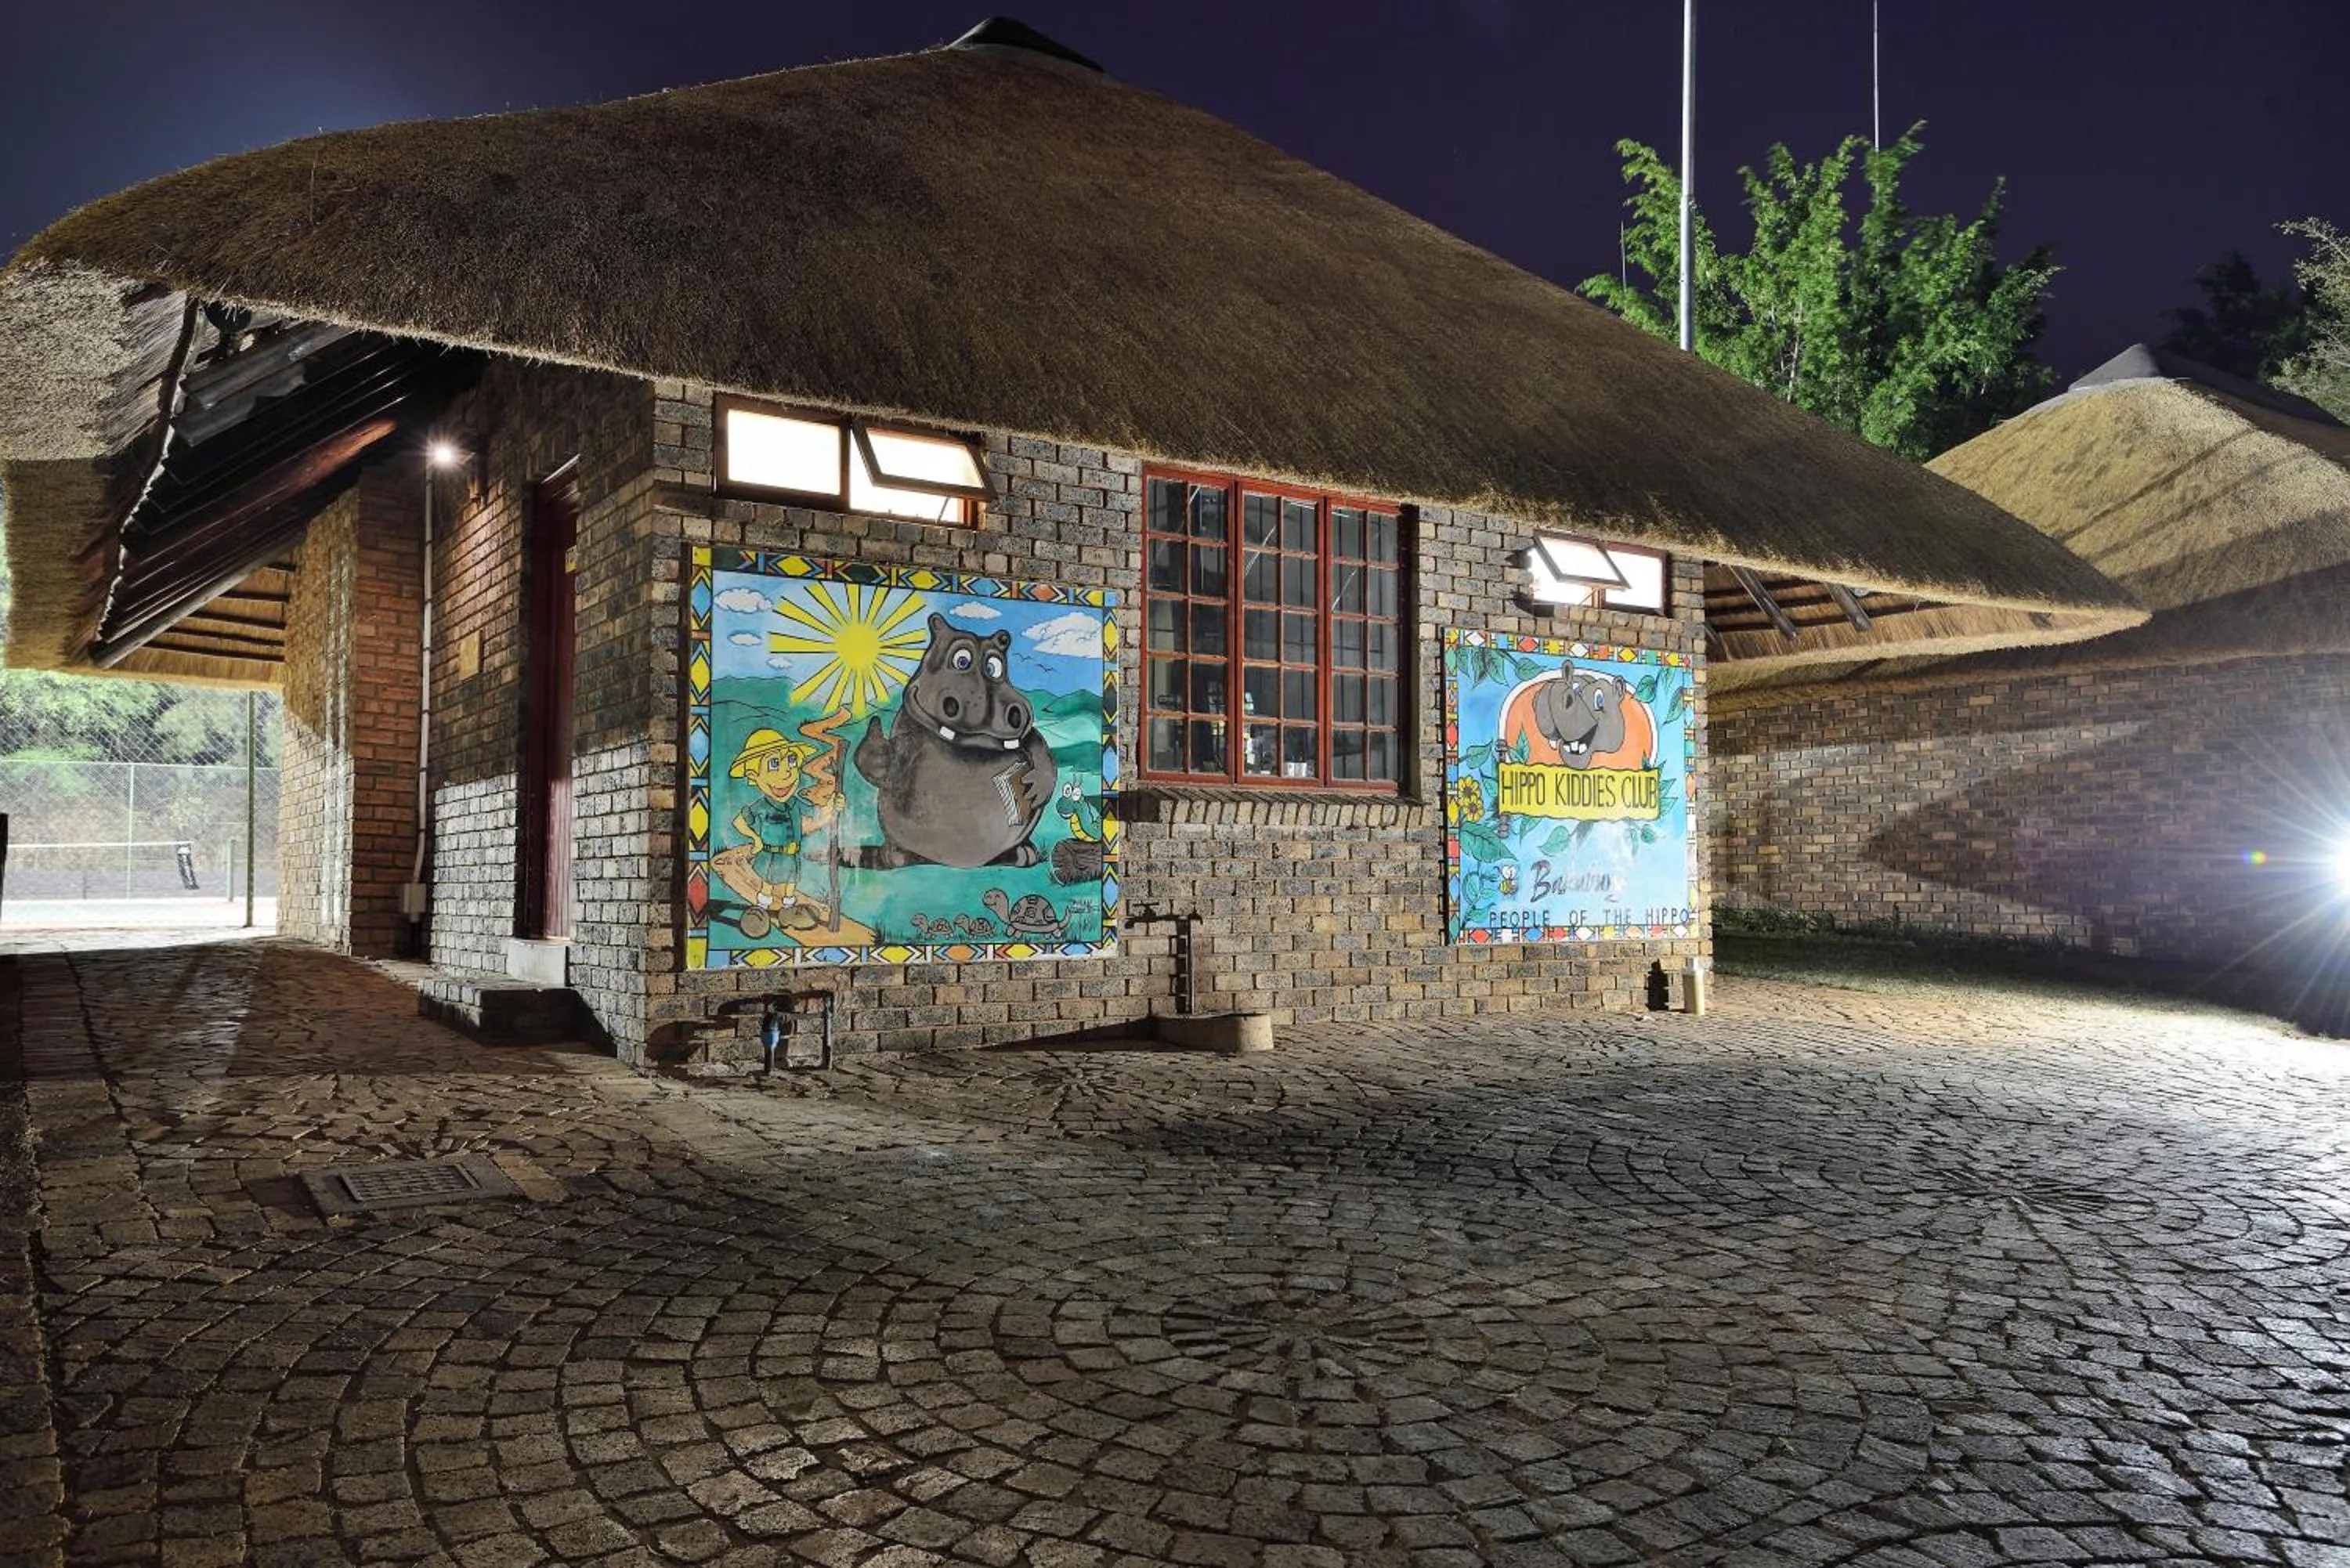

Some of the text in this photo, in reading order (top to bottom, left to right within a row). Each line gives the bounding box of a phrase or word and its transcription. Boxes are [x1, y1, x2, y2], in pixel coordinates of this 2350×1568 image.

[1501, 770, 1658, 809] HIPPO KIDDIES CLUB
[1489, 907, 1690, 928] PEOPLE OF THE HIPPO
